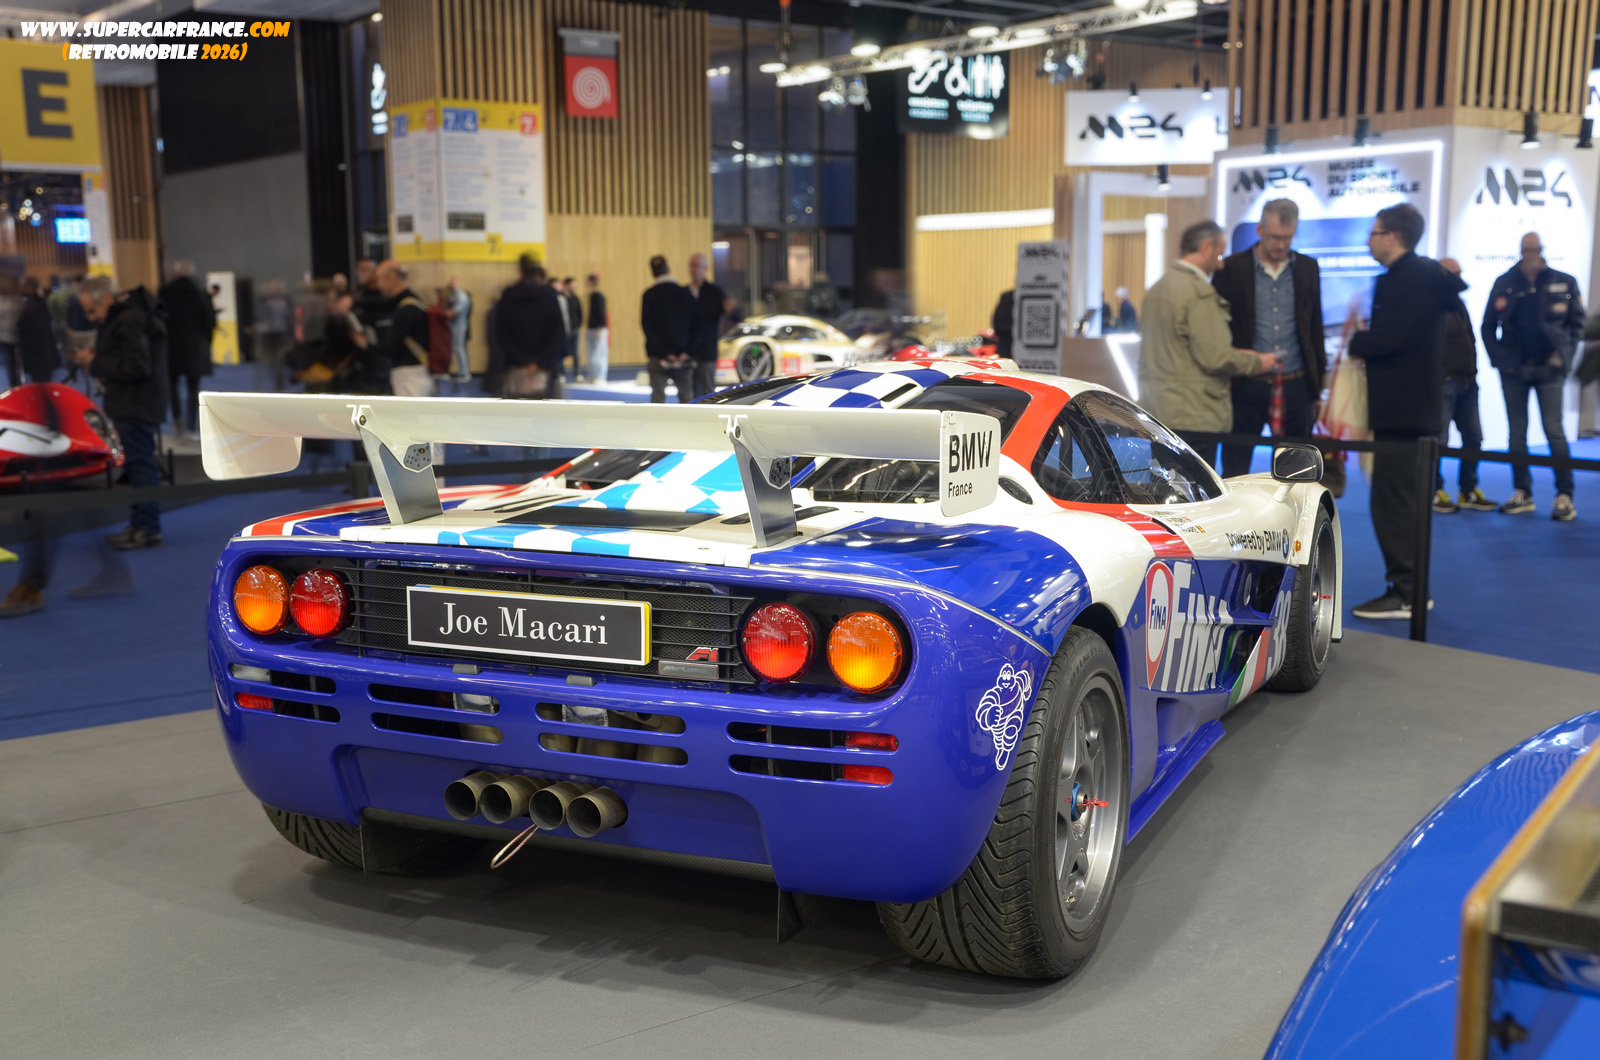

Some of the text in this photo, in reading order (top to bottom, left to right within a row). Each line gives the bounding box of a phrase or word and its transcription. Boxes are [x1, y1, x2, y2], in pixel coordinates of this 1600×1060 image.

[21, 67, 74, 139] E
[948, 430, 993, 474] BMW
[948, 481, 973, 498] France
[1225, 530, 1282, 555] powered by BMW
[439, 602, 608, 645] Joe Macari
[1150, 598, 1167, 630] FINA
[1160, 561, 1234, 693] FINA
[1266, 590, 1292, 681] 38
